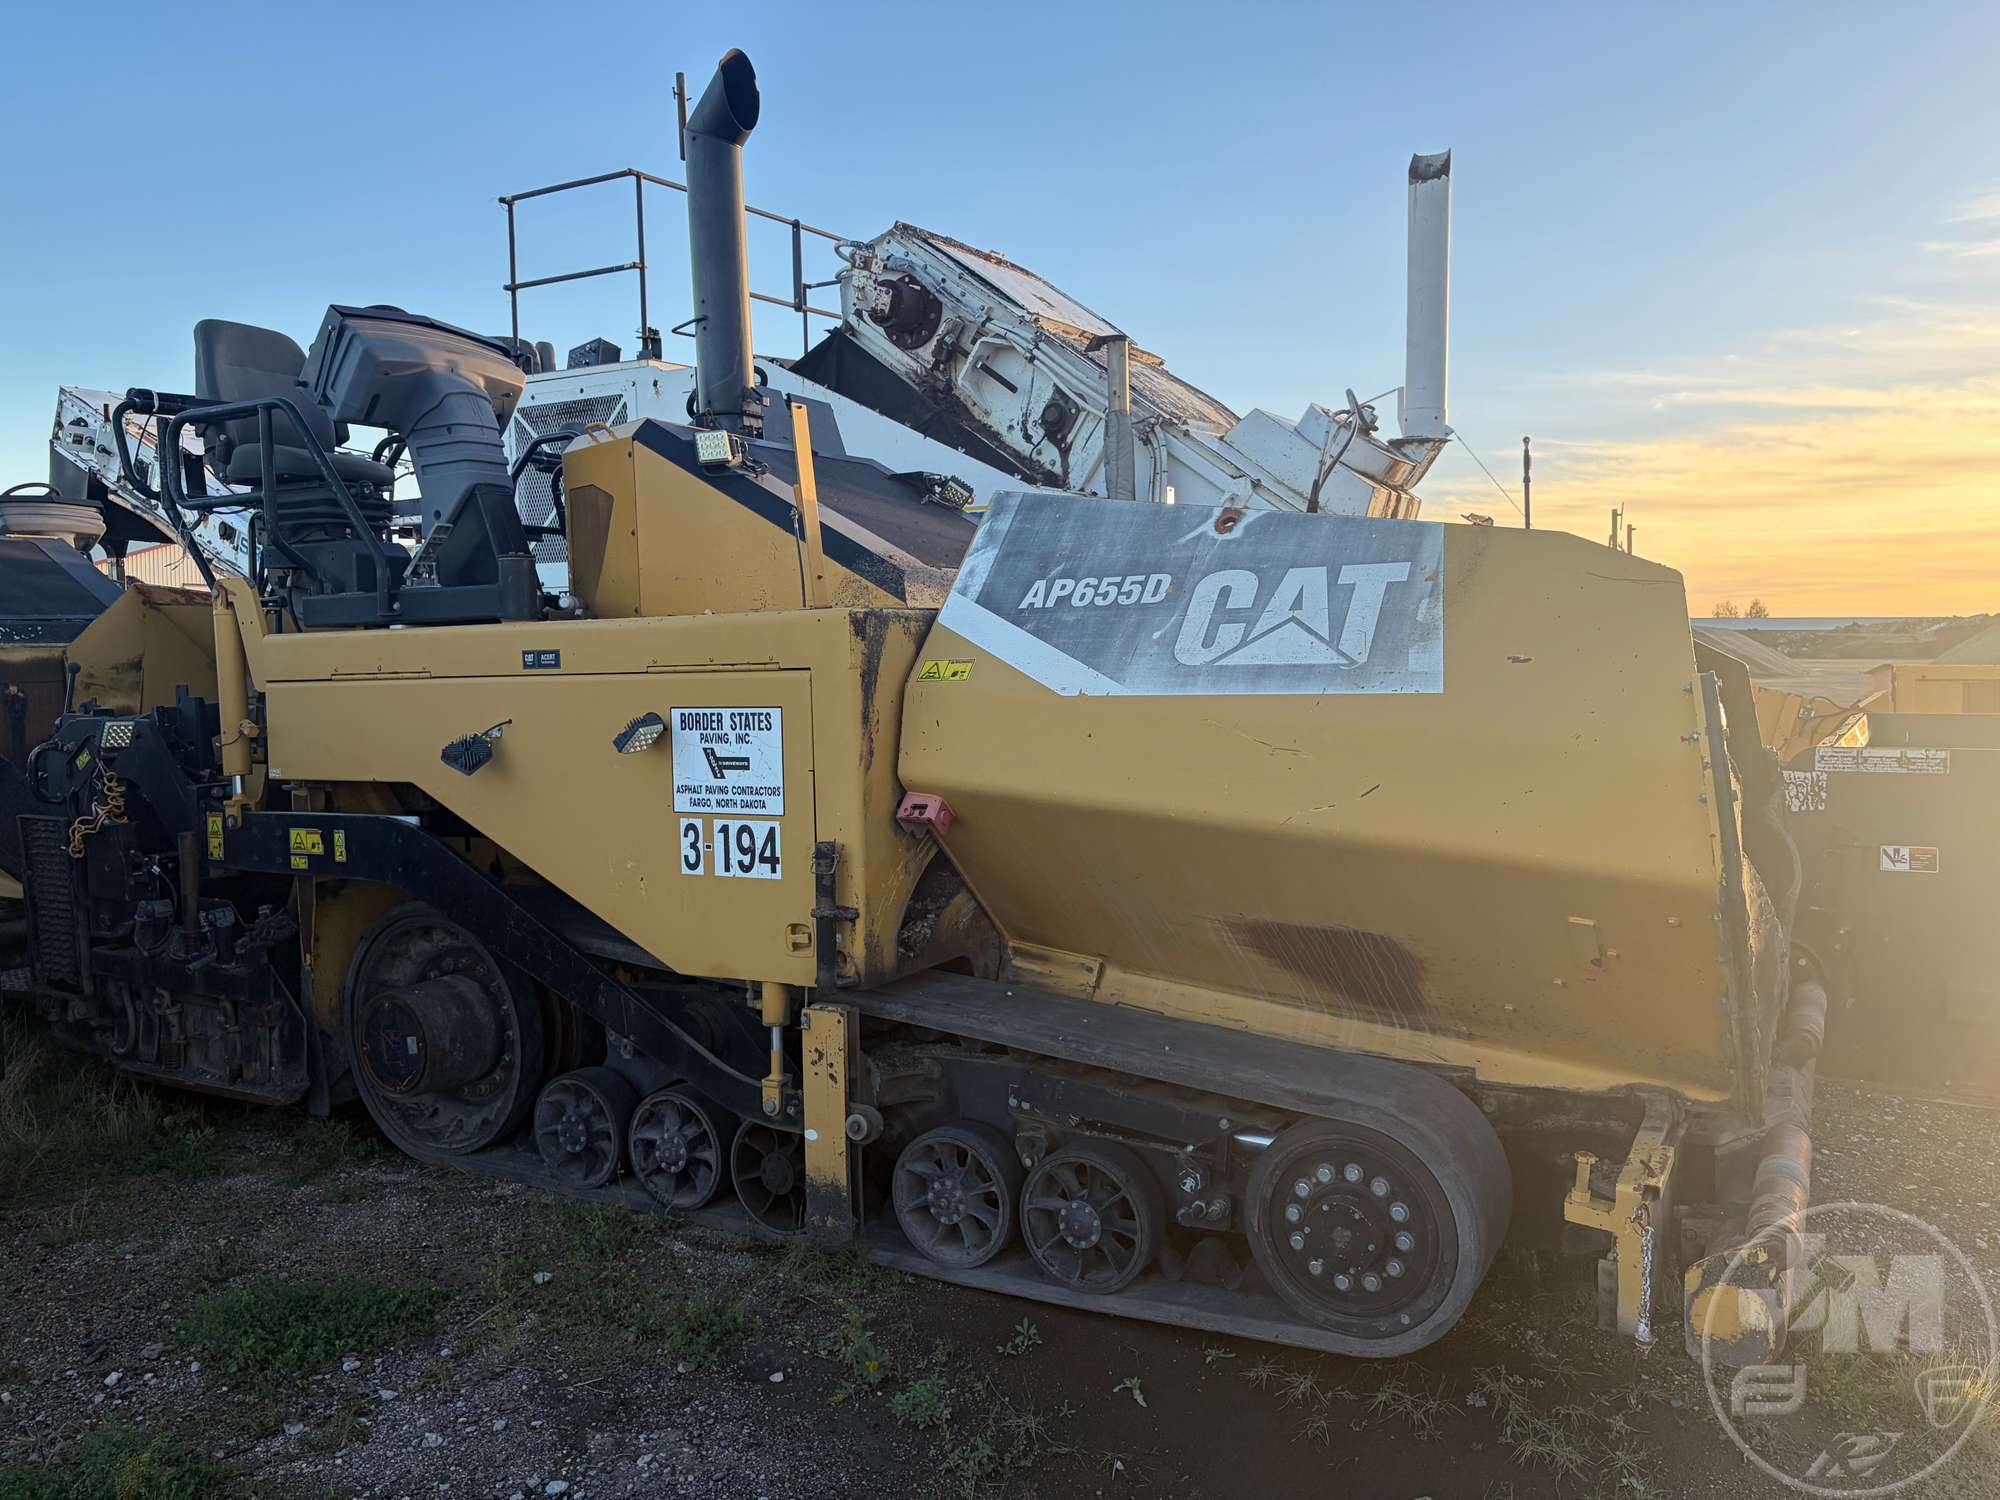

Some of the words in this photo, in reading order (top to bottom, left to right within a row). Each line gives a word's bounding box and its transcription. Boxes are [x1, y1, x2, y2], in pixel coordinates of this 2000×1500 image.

[1018, 573, 1172, 609] AP655D
[1174, 562, 1412, 666] CAT
[680, 712, 723, 731] BORDER
[729, 712, 773, 731] STATES
[699, 733, 732, 747] PAVING,
[735, 733, 753, 744] INC.
[676, 784, 702, 795] ASPHALT
[704, 785, 729, 796] PAVING
[731, 786, 781, 797] CONTRACTORS
[689, 797, 713, 809] FARGO,
[715, 798, 738, 809] NORTH
[740, 799, 767, 809] DAKOTA
